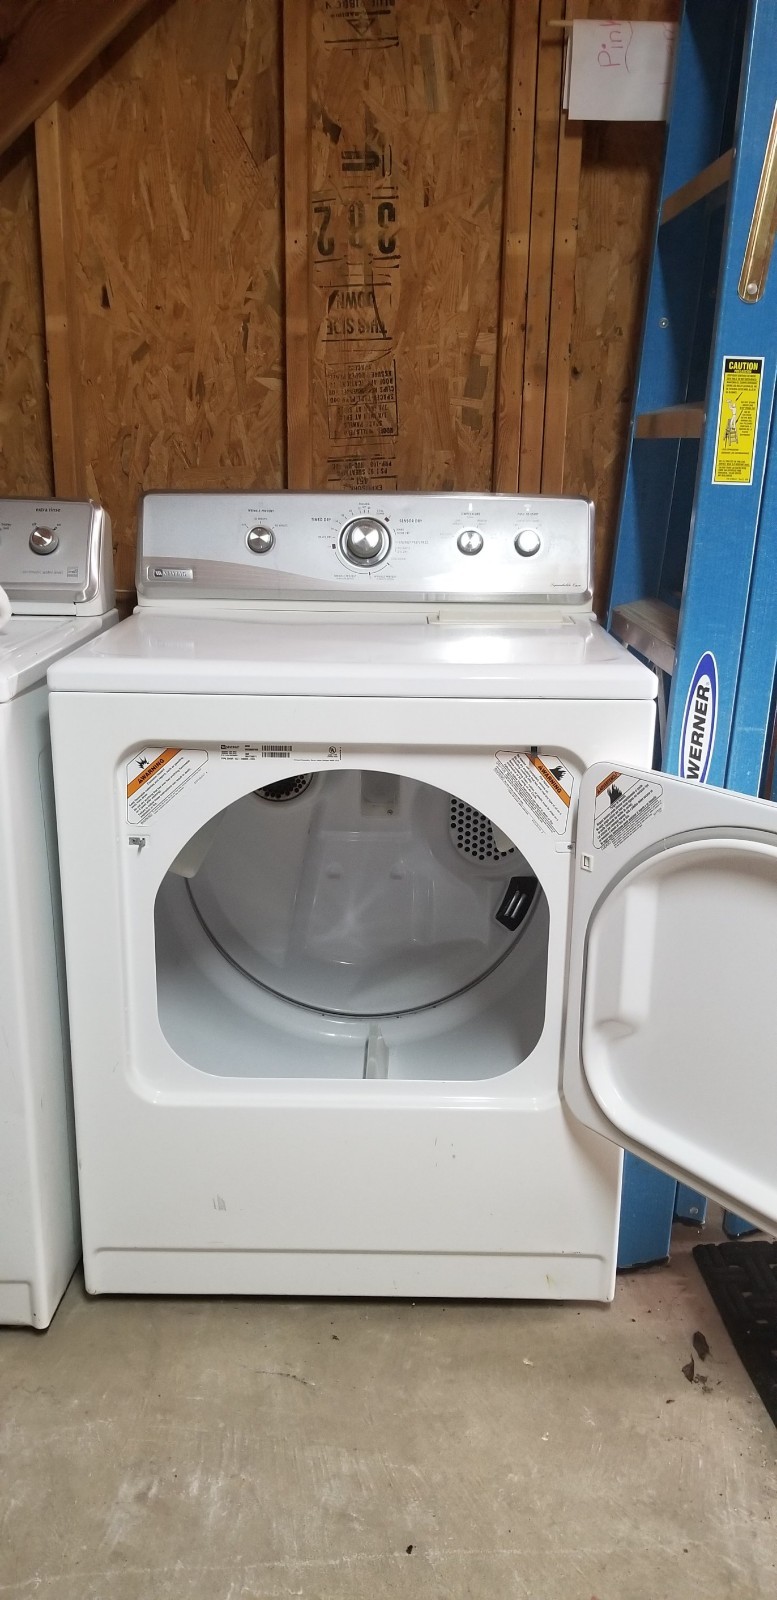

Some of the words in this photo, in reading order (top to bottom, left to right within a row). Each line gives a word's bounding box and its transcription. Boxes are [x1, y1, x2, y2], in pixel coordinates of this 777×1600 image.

[728, 361, 759, 371] CAUTION
[686, 684, 711, 780] WERNER
[141, 757, 166, 782] WARNING
[541, 766, 562, 794] WARNING
